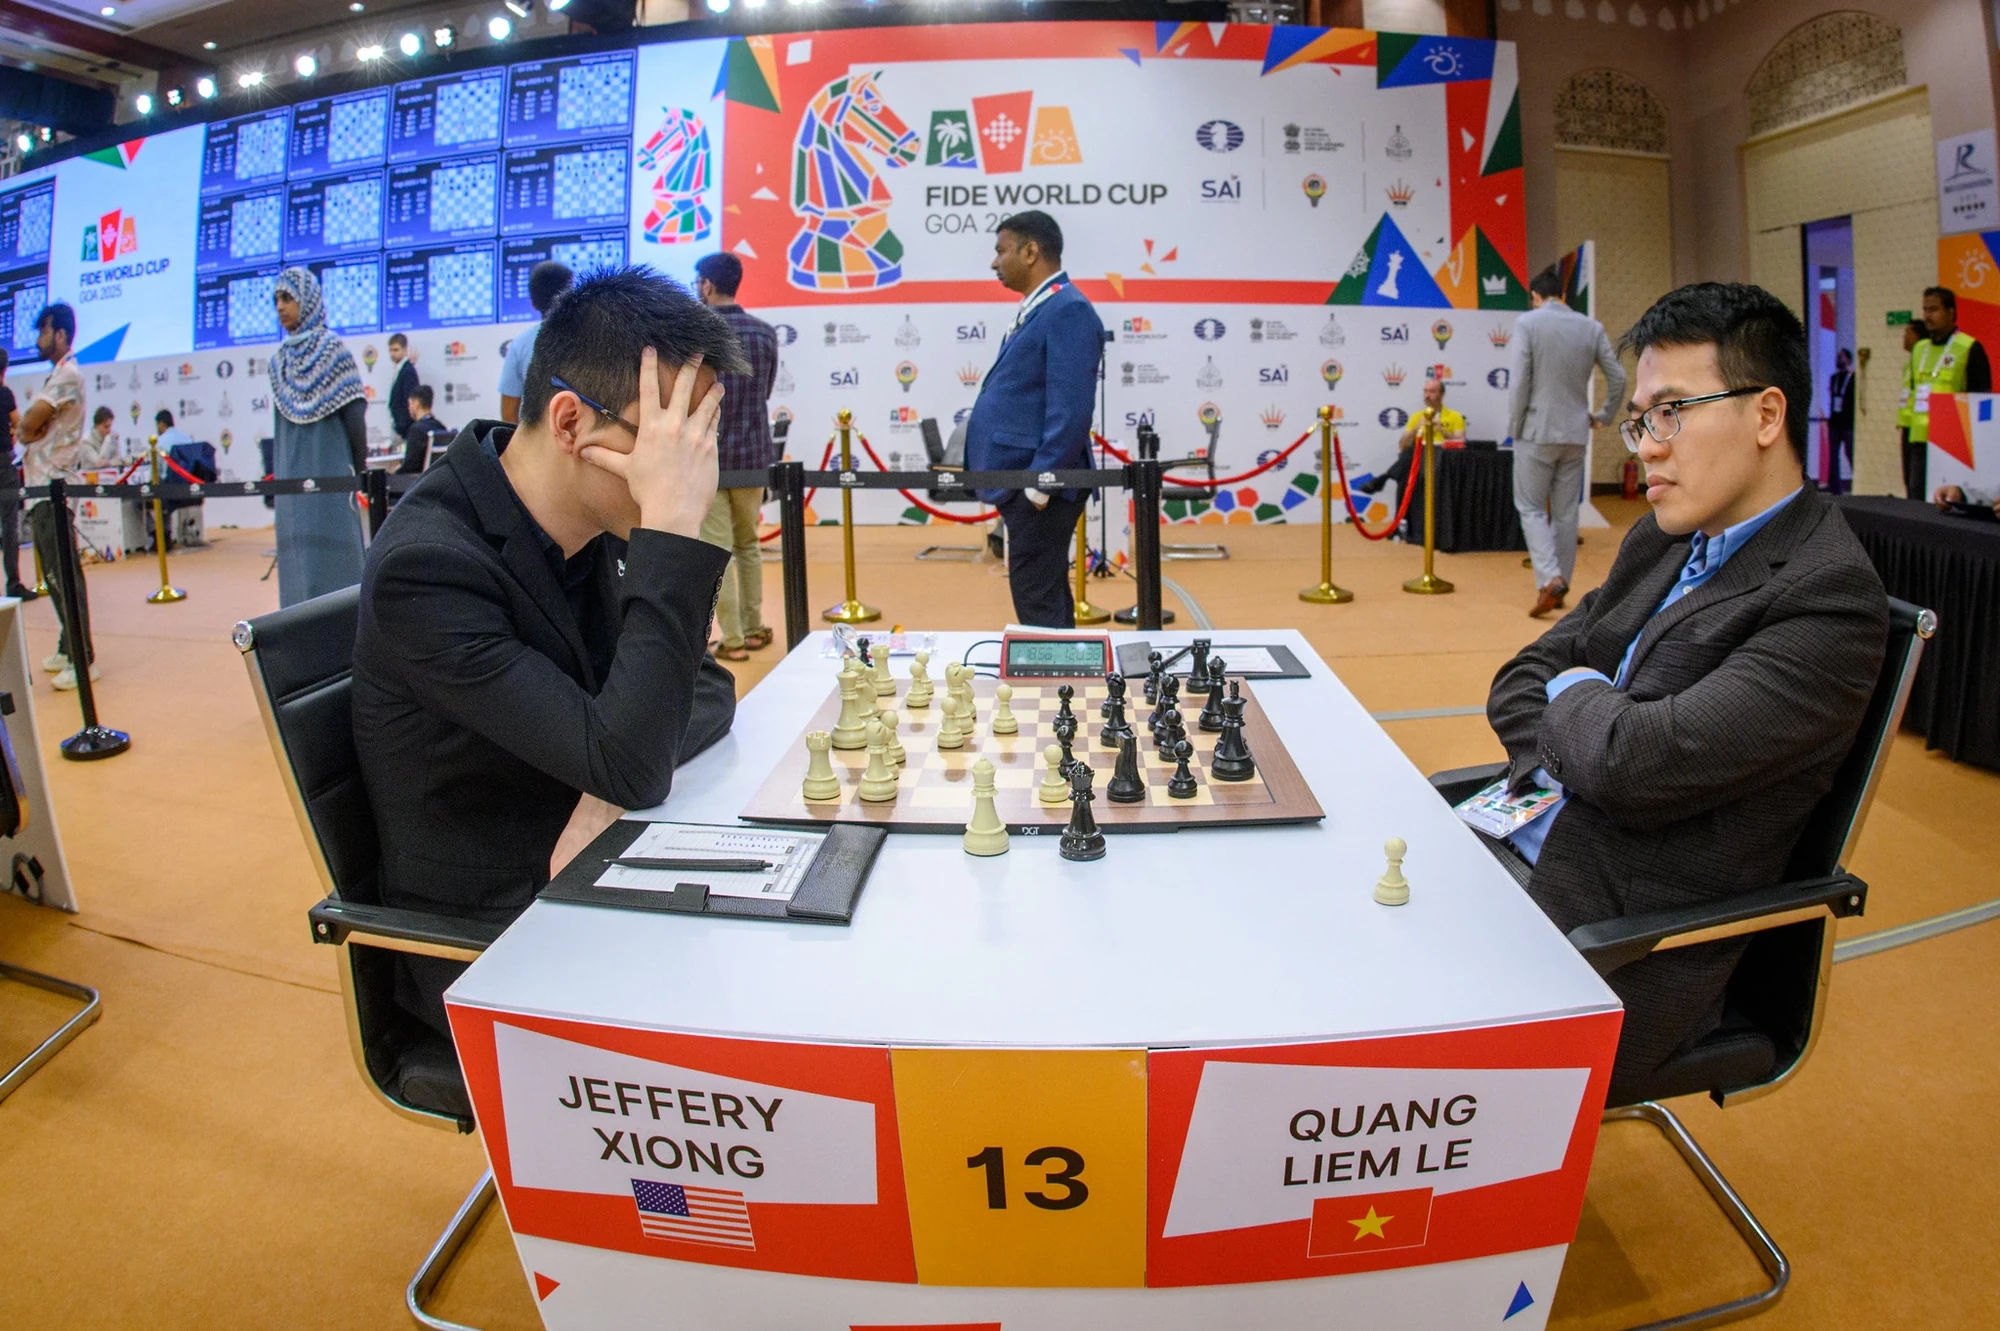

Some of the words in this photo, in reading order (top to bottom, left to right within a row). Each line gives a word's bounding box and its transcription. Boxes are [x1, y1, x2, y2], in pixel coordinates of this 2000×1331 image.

[925, 185, 988, 206] FIDE
[994, 184, 1101, 206] WORLD
[1108, 183, 1168, 205] CUP
[1201, 177, 1241, 199] SAI
[925, 213, 978, 234] GOA
[80, 270, 102, 287] FIDE
[104, 263, 144, 282] WORLD
[145, 258, 170, 276] CUP
[79, 289, 98, 304] GOA
[956, 323, 986, 340] SAI
[1381, 325, 1409, 341] SAI
[830, 370, 859, 386] SAI
[1259, 367, 1288, 383] SAI
[1021, 826, 1040, 836] DGT
[558, 1075, 783, 1132] JEFFERY
[1289, 1094, 1477, 1142] QUANG
[592, 1127, 765, 1179] XIONG
[1283, 1146, 1401, 1186] LIEM
[1416, 1138, 1473, 1174] LE
[966, 1146, 1089, 1211] 13
